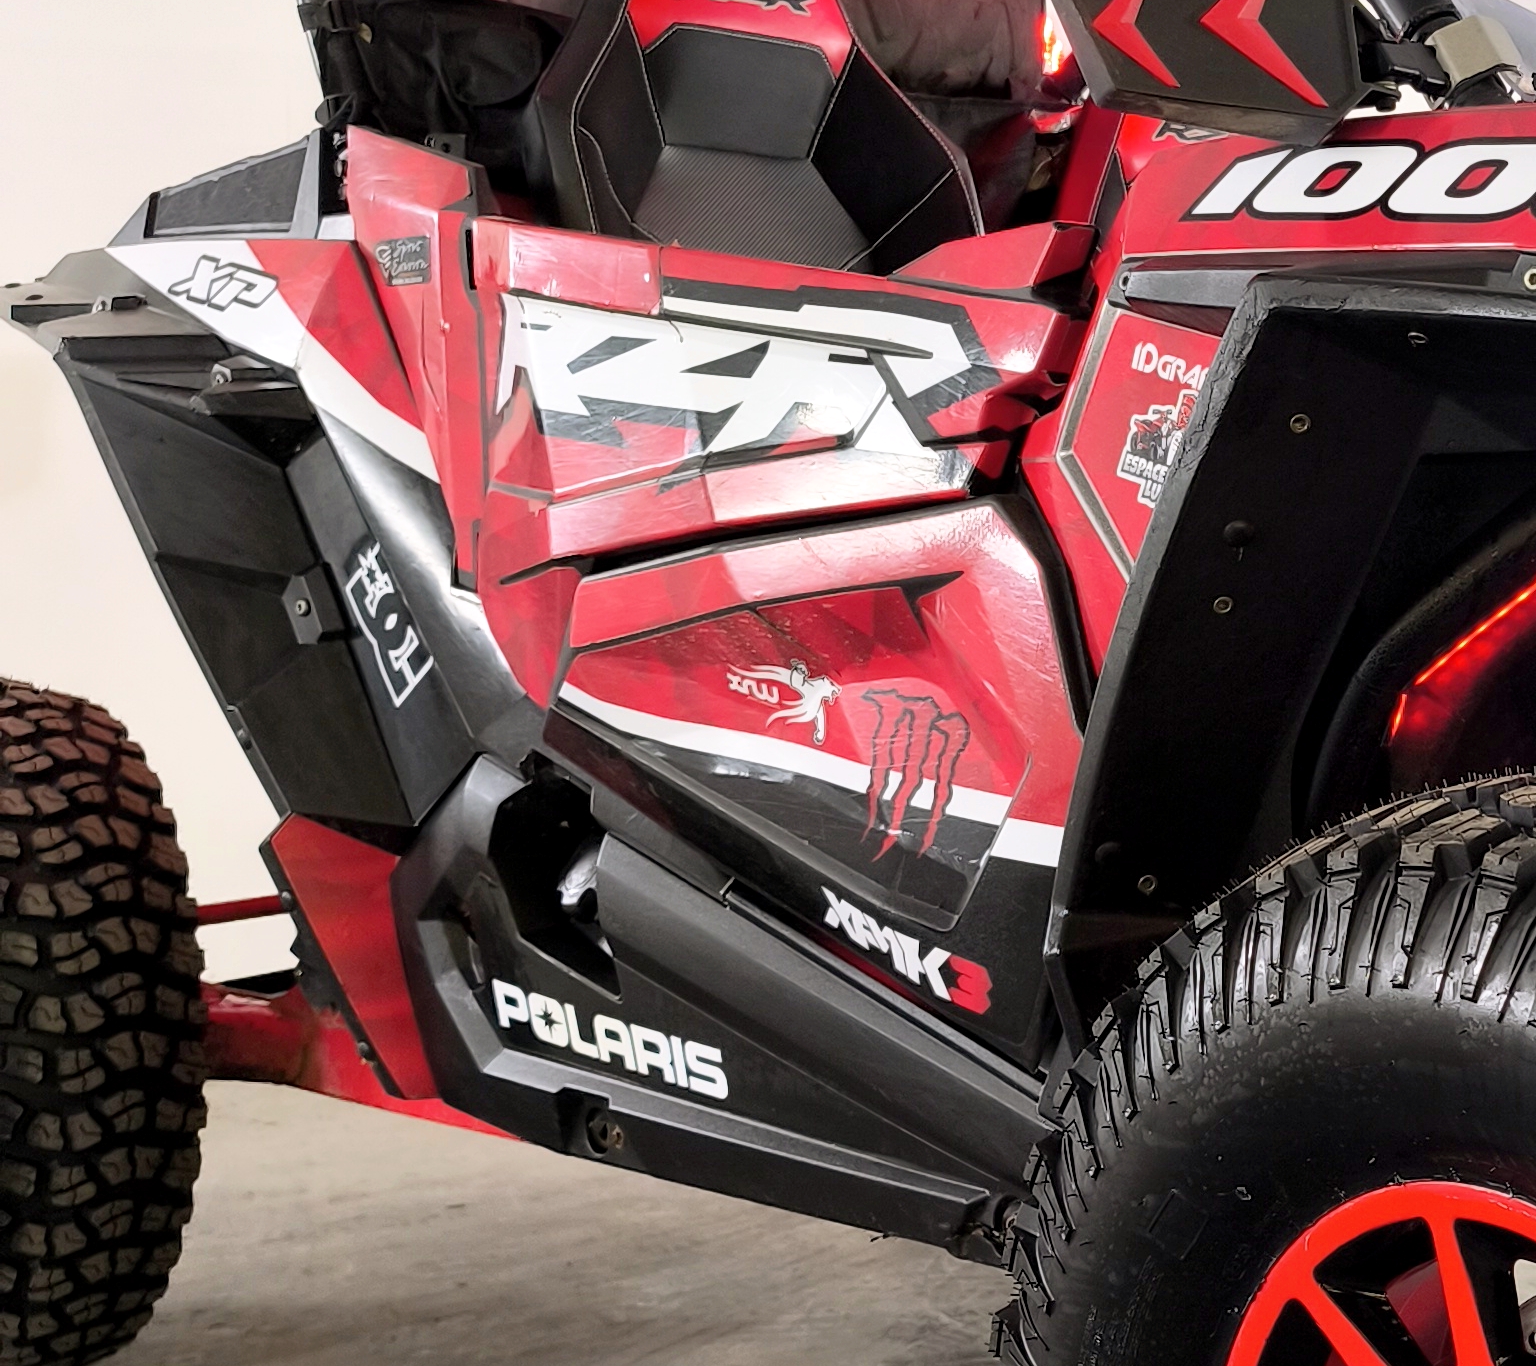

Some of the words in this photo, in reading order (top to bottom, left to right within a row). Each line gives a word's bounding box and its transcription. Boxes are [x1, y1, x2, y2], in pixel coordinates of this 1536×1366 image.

[168, 254, 278, 311] XP
[494, 280, 978, 460] RZR
[491, 978, 729, 1100] POLARIS
